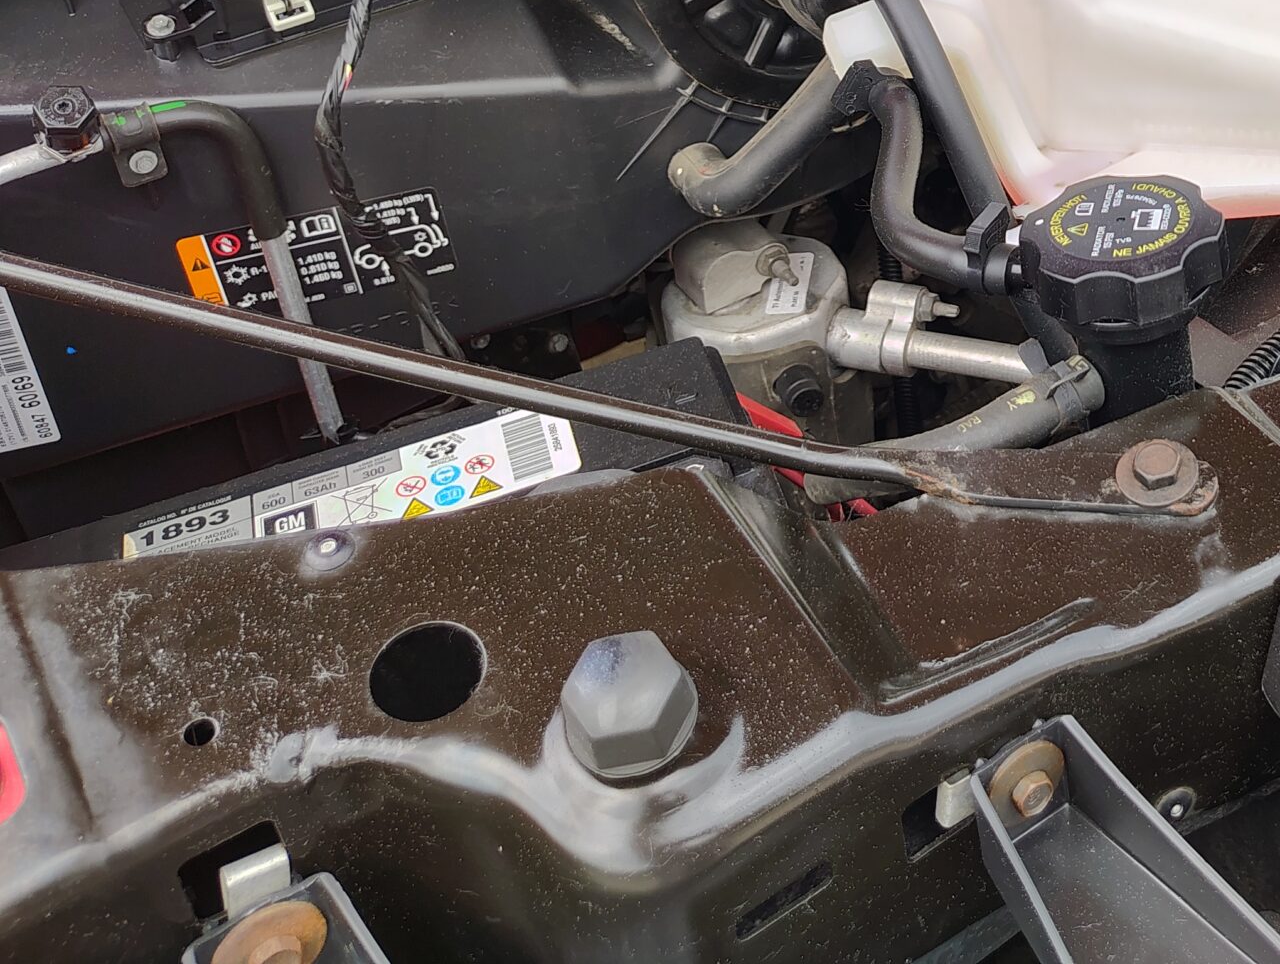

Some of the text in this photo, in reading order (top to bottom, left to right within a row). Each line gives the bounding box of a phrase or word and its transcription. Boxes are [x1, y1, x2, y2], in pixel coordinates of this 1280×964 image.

[1113, 248, 1132, 257] NE
[1136, 232, 1177, 254] JAMAIS
[297, 250, 337, 266] 1.410 kg
[300, 260, 340, 275] 0.810 kg
[330, 270, 343, 281] kg
[12, 375, 41, 409] 60/69
[362, 466, 385, 480] 300
[304, 482, 337, 497] 63Ah
[261, 497, 286, 511] 600
[138, 514, 167, 528] CATALOG
[140, 508, 231, 547] 1893
[275, 511, 306, 533] GM
[157, 537, 201, 554] ACEMENT
